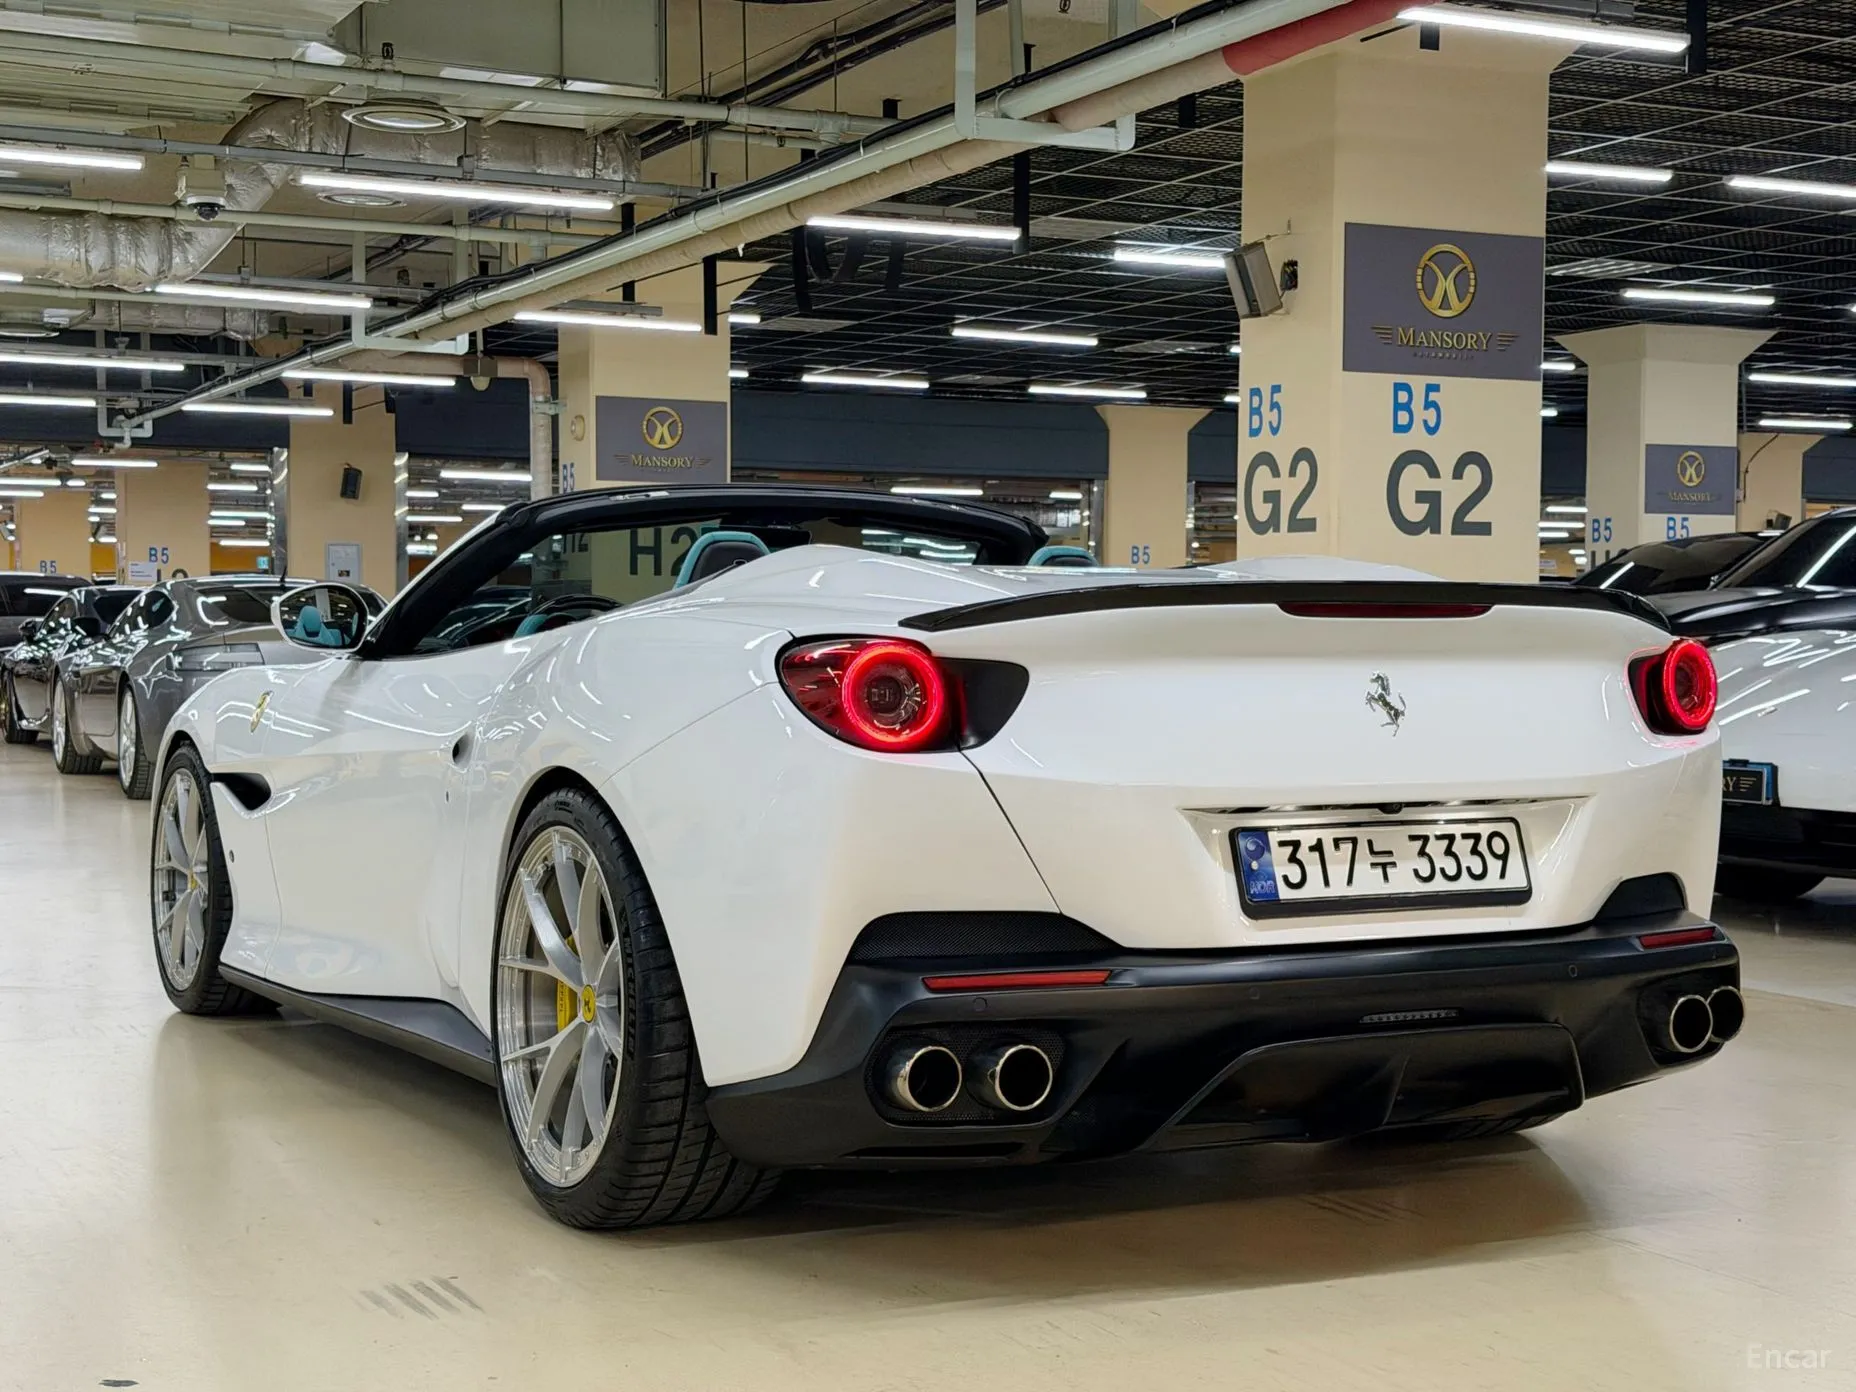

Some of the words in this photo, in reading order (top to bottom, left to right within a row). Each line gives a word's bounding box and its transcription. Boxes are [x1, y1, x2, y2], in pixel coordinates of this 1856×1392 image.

[1397, 327, 1492, 351] MANSORY
[1248, 384, 1282, 438] B5
[1393, 382, 1442, 436] B5
[631, 454, 695, 468] MANSORY
[1244, 447, 1318, 535] G2
[1386, 450, 1493, 536] G2
[1592, 518, 1612, 543] B5
[1666, 517, 1690, 540] B5
[149, 547, 169, 564] B5
[630, 526, 698, 577] H2
[1131, 545, 1150, 565] B5
[40, 560, 57, 574] B5
[1277, 836, 1398, 890] 317누
[1407, 830, 1511, 883] 3339
